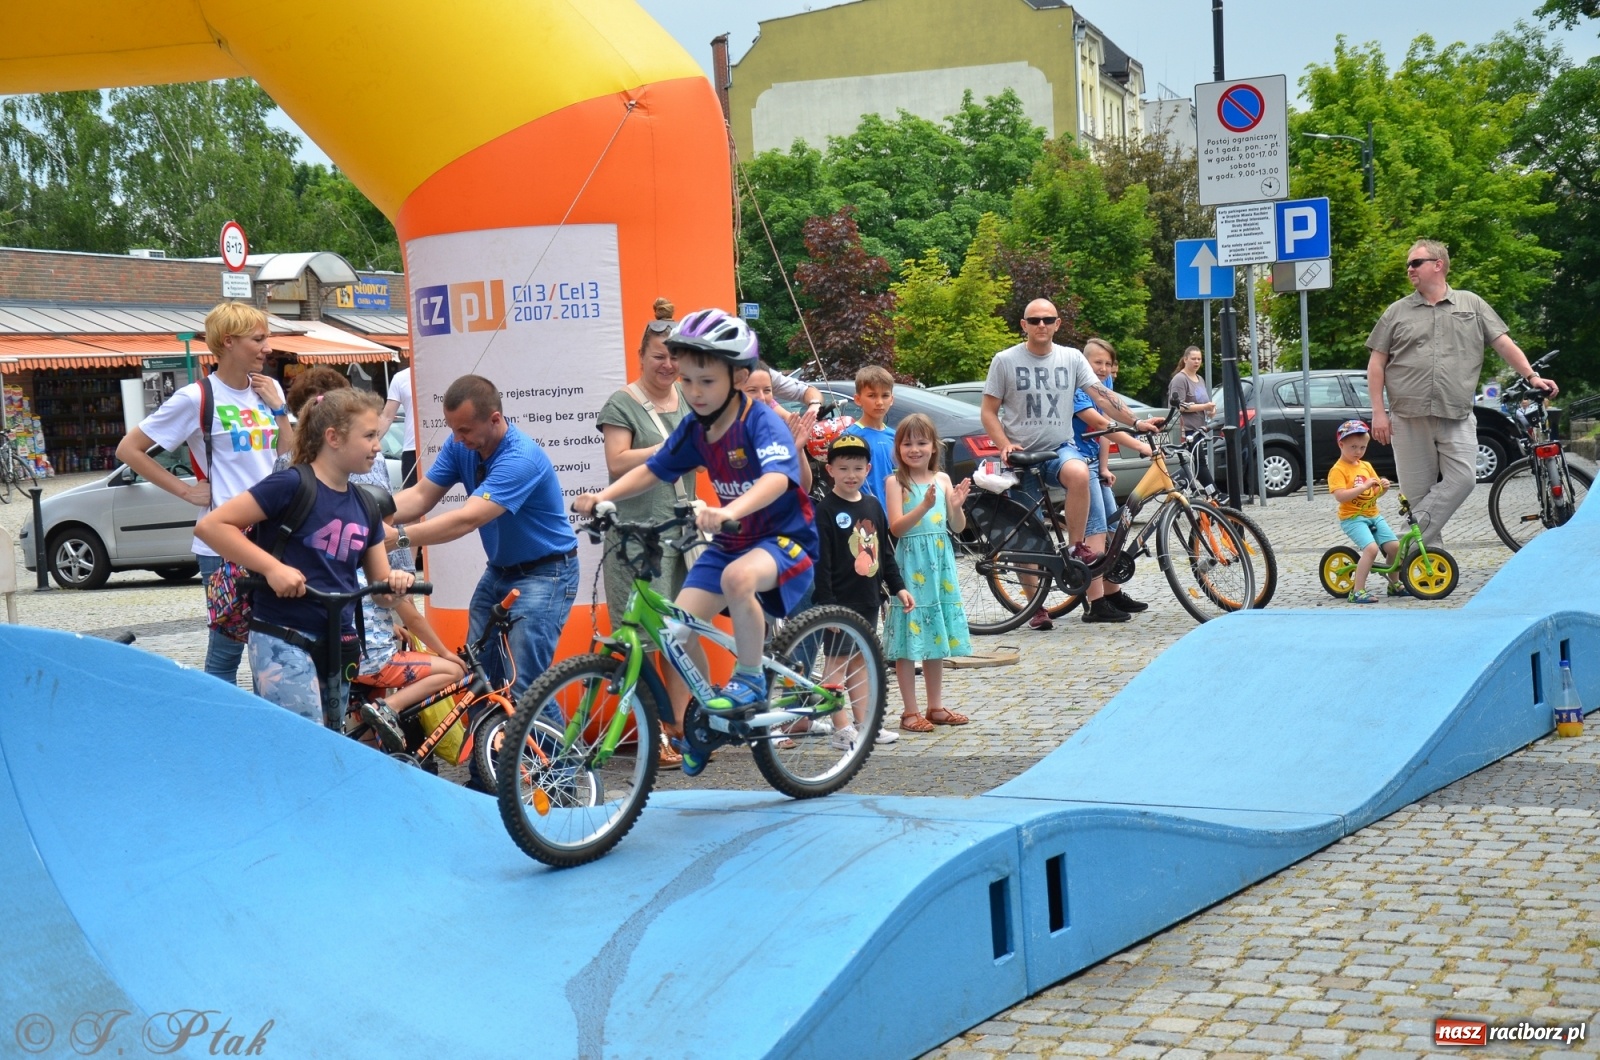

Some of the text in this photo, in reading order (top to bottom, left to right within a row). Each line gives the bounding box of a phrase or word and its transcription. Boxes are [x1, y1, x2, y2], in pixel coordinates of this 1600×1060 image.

[1232, 133, 1278, 145] ograniczony
[1222, 146, 1242, 155] godz.
[1245, 144, 1261, 152] pon.
[1270, 141, 1281, 150] pt.
[1215, 155, 1236, 164] godz.
[1238, 149, 1278, 160] 9.00-17.00
[1230, 162, 1256, 170] sobota
[1215, 172, 1236, 182] godz.
[1238, 167, 1279, 178] 9.00-13.00
[1284, 206, 1317, 254] P
[226, 241, 242, 255] 8-12
[354, 282, 388, 296] SŁODYCZE
[559, 282, 585, 301] Cel
[1015, 366, 1069, 391] BRO
[506, 386, 584, 400] rejestracyjnym
[1026, 393, 1060, 419] NX
[555, 412, 574, 421] bez
[577, 412, 601, 421] gran
[427, 446, 437, 455] jest
[756, 442, 789, 459] beko
[553, 461, 590, 473] ozwoju
[303, 518, 370, 563] 4F
